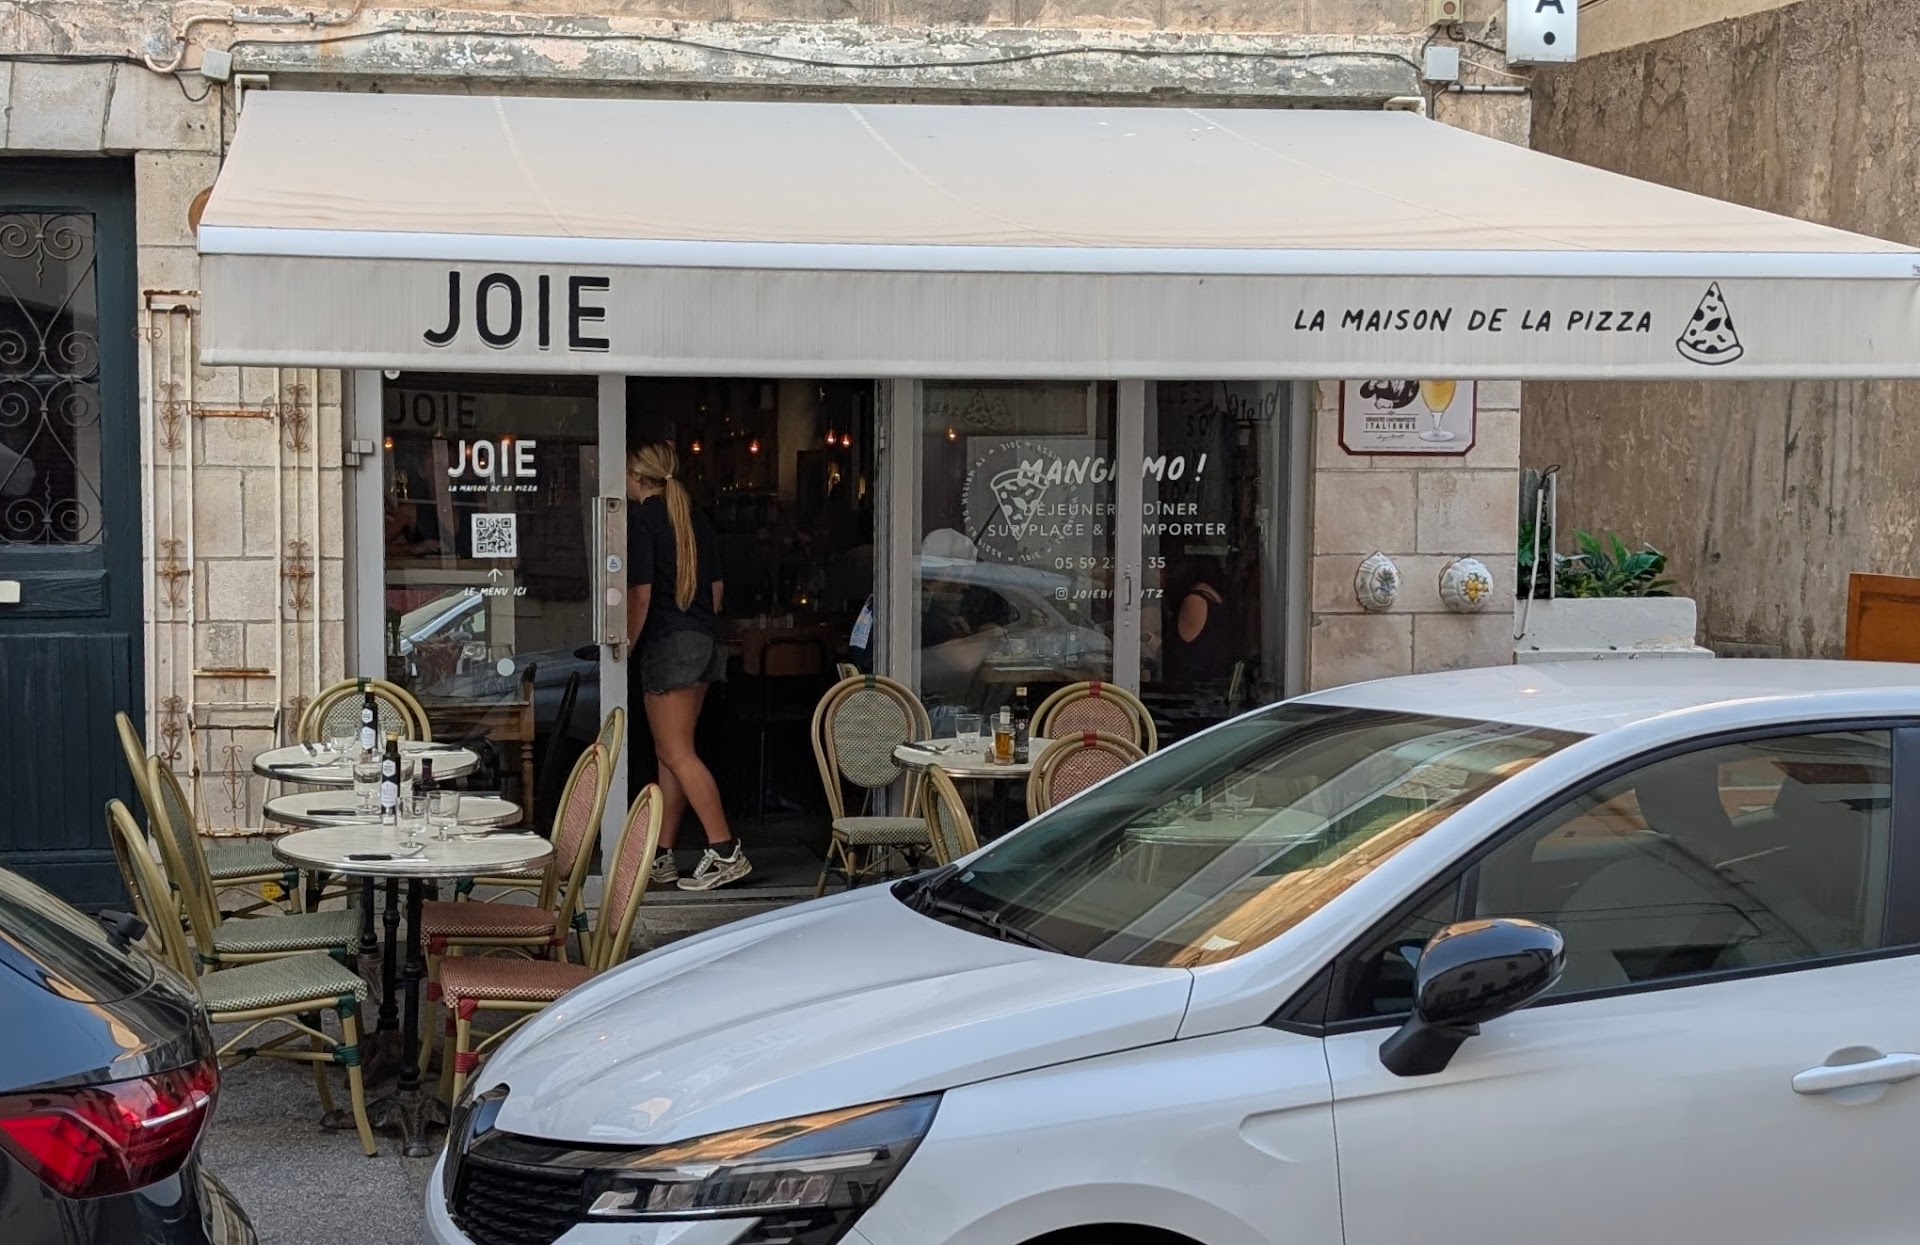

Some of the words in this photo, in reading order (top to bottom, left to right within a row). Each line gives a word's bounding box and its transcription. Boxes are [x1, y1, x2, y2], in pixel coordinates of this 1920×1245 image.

[423, 271, 609, 352] JOIE
[1294, 308, 1325, 332] LA
[1341, 307, 1452, 332] MAISON
[1467, 308, 1507, 332] DE
[1520, 309, 1552, 332] LA
[1567, 310, 1652, 332] PIZZA
[447, 440, 537, 477] JOIE
[1017, 455, 1185, 485] MANGIMO
[1023, 502, 1115, 516] DÉJEUNER
[1143, 500, 1198, 516] DÎNER
[987, 524, 1020, 537] SUR
[1029, 524, 1084, 537] PLACE
[1093, 523, 1104, 536] &
[1141, 523, 1227, 536] MPORTER
[1055, 557, 1073, 569] 05
[1080, 557, 1096, 569] 59
[1148, 556, 1166, 569] 35
[464, 587, 476, 596] LE
[480, 587, 509, 597] MENU
[513, 587, 527, 596] ICI
[1072, 588, 1164, 599] JOIEBIITZ
